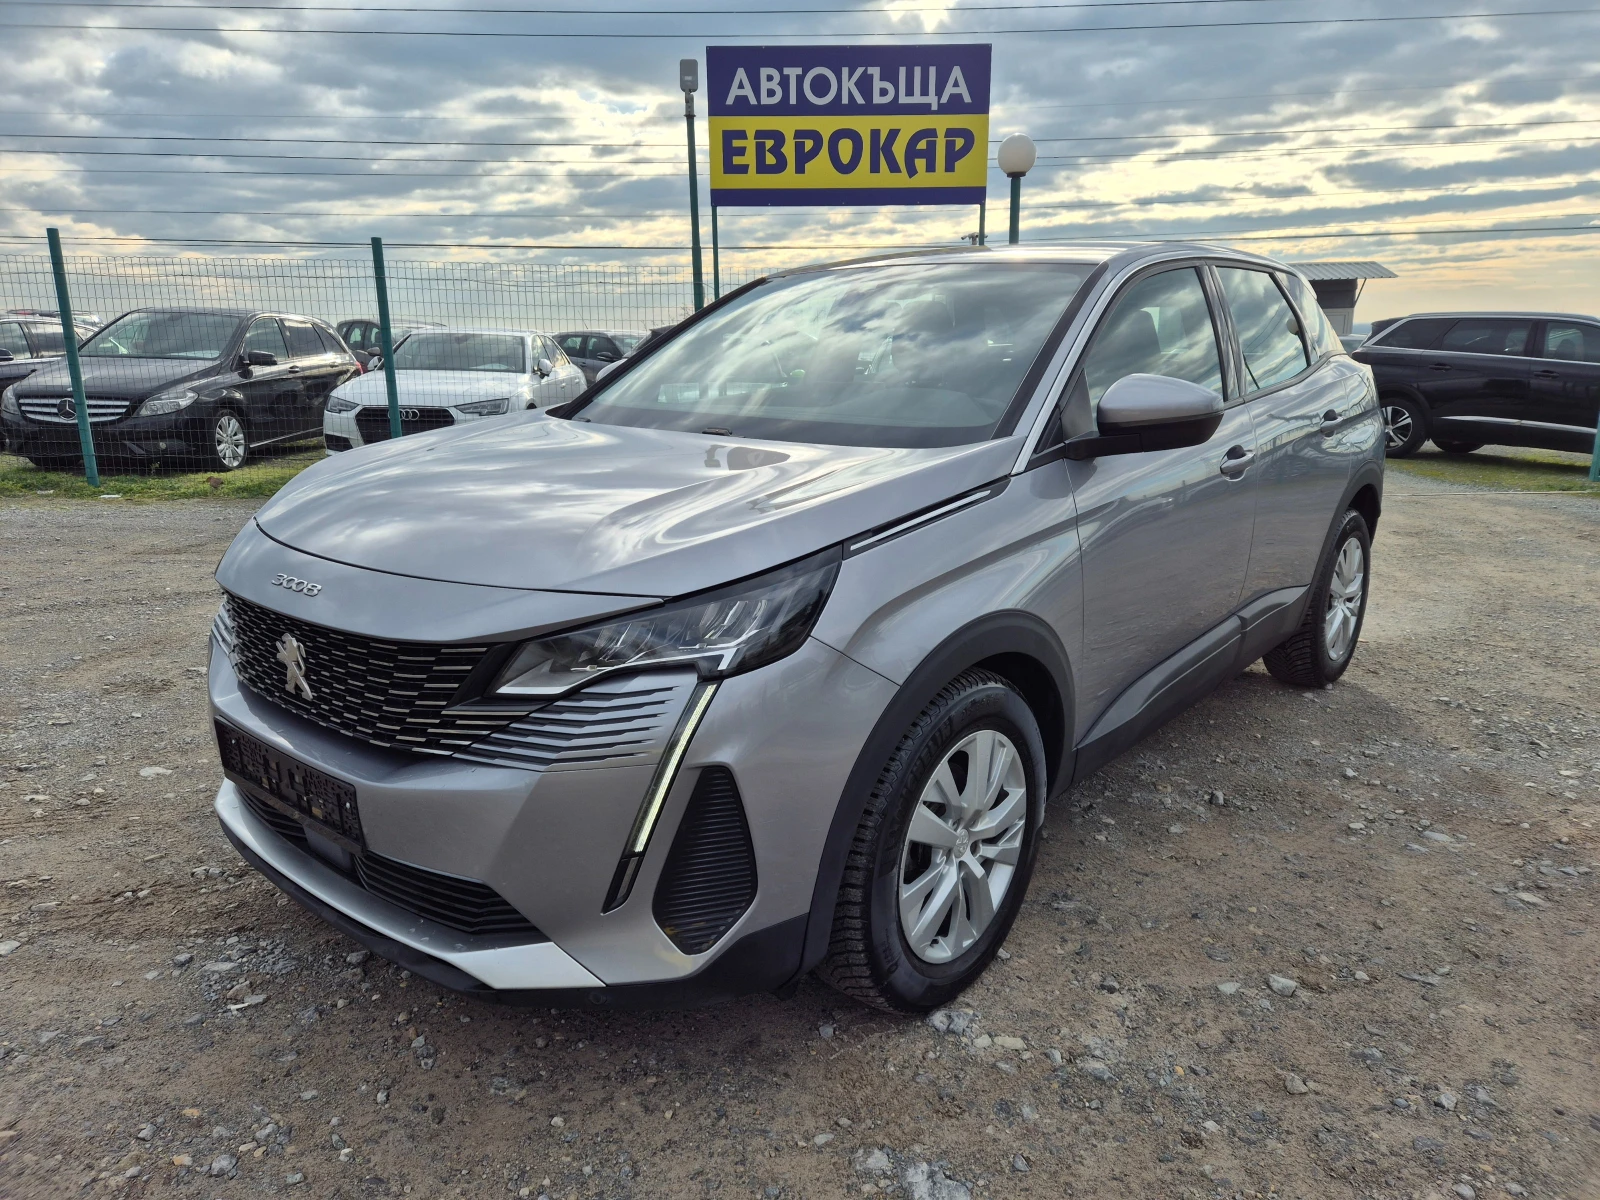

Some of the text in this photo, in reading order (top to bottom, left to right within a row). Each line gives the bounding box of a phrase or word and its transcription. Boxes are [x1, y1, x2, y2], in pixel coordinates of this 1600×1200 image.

[725, 65, 972, 111] АВТОКЪЩА
[721, 127, 975, 179] ЕВРОКАР
[271, 573, 322, 597] 3008
